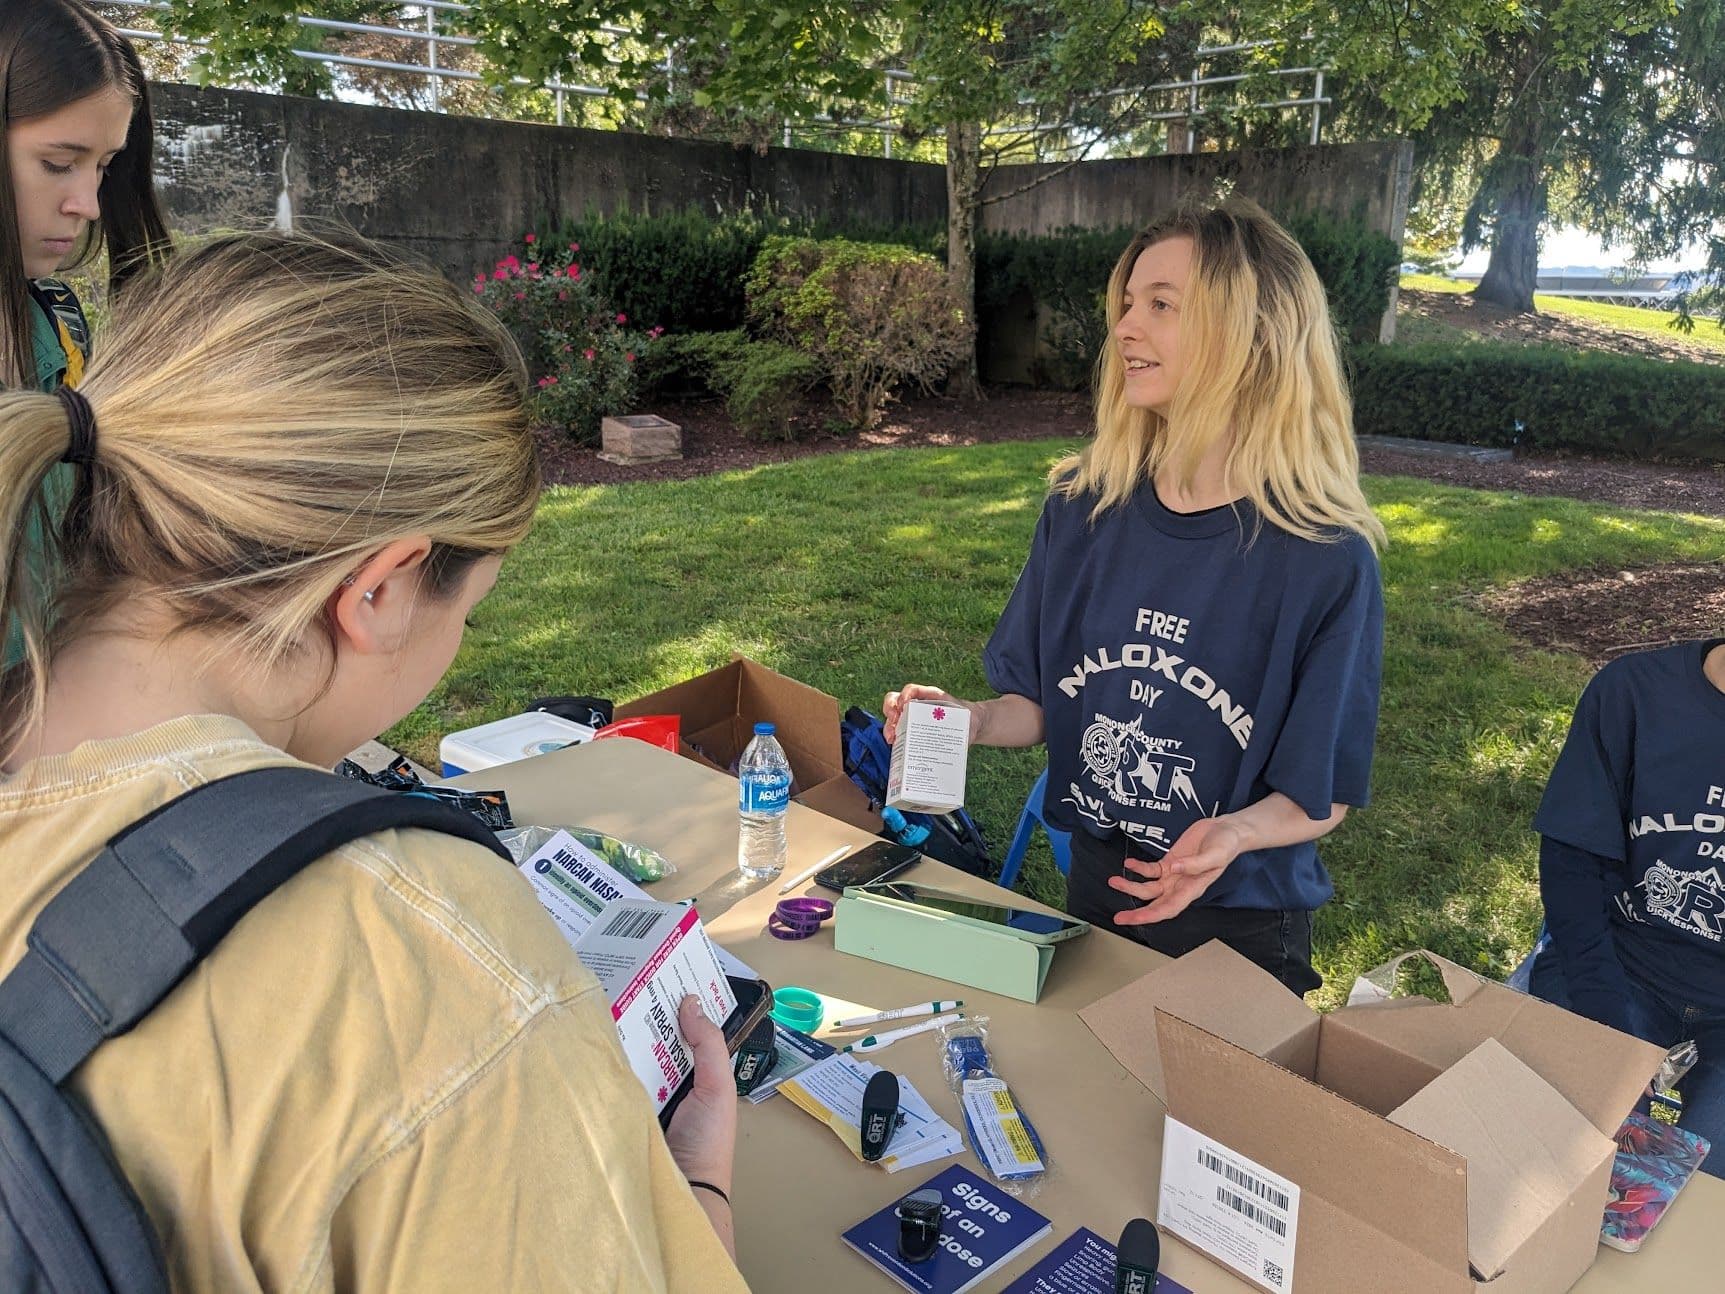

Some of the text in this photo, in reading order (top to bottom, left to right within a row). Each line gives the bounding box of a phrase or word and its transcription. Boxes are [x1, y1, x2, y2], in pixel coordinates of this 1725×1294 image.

[1135, 607, 1190, 644] FREE
[1058, 643, 1254, 750] NALOXONE
[1130, 680, 1164, 708] DAY
[1140, 799, 1172, 812] TEAM
[1629, 813, 1725, 840] NALO
[564, 842, 618, 887] How to administer
[1698, 841, 1725, 863] DA
[552, 848, 624, 902] NARCAN NASA
[1656, 859, 1716, 889] MONONGALIA
[1668, 916, 1722, 942] RESPONSE
[650, 1002, 674, 1041] SPRAY
[653, 1040, 680, 1090] NARCAN
[668, 1035, 690, 1076] NASAL
[740, 1054, 757, 1080] QRT
[868, 1114, 884, 1144] QRT
[952, 1182, 1011, 1223] Signs
[940, 1204, 984, 1238] of an
[1074, 1254, 1105, 1275] Limp Body
[1086, 1238, 1117, 1261] You mig
[1036, 1278, 1057, 1294] They
[1128, 1270, 1142, 1294] RT
